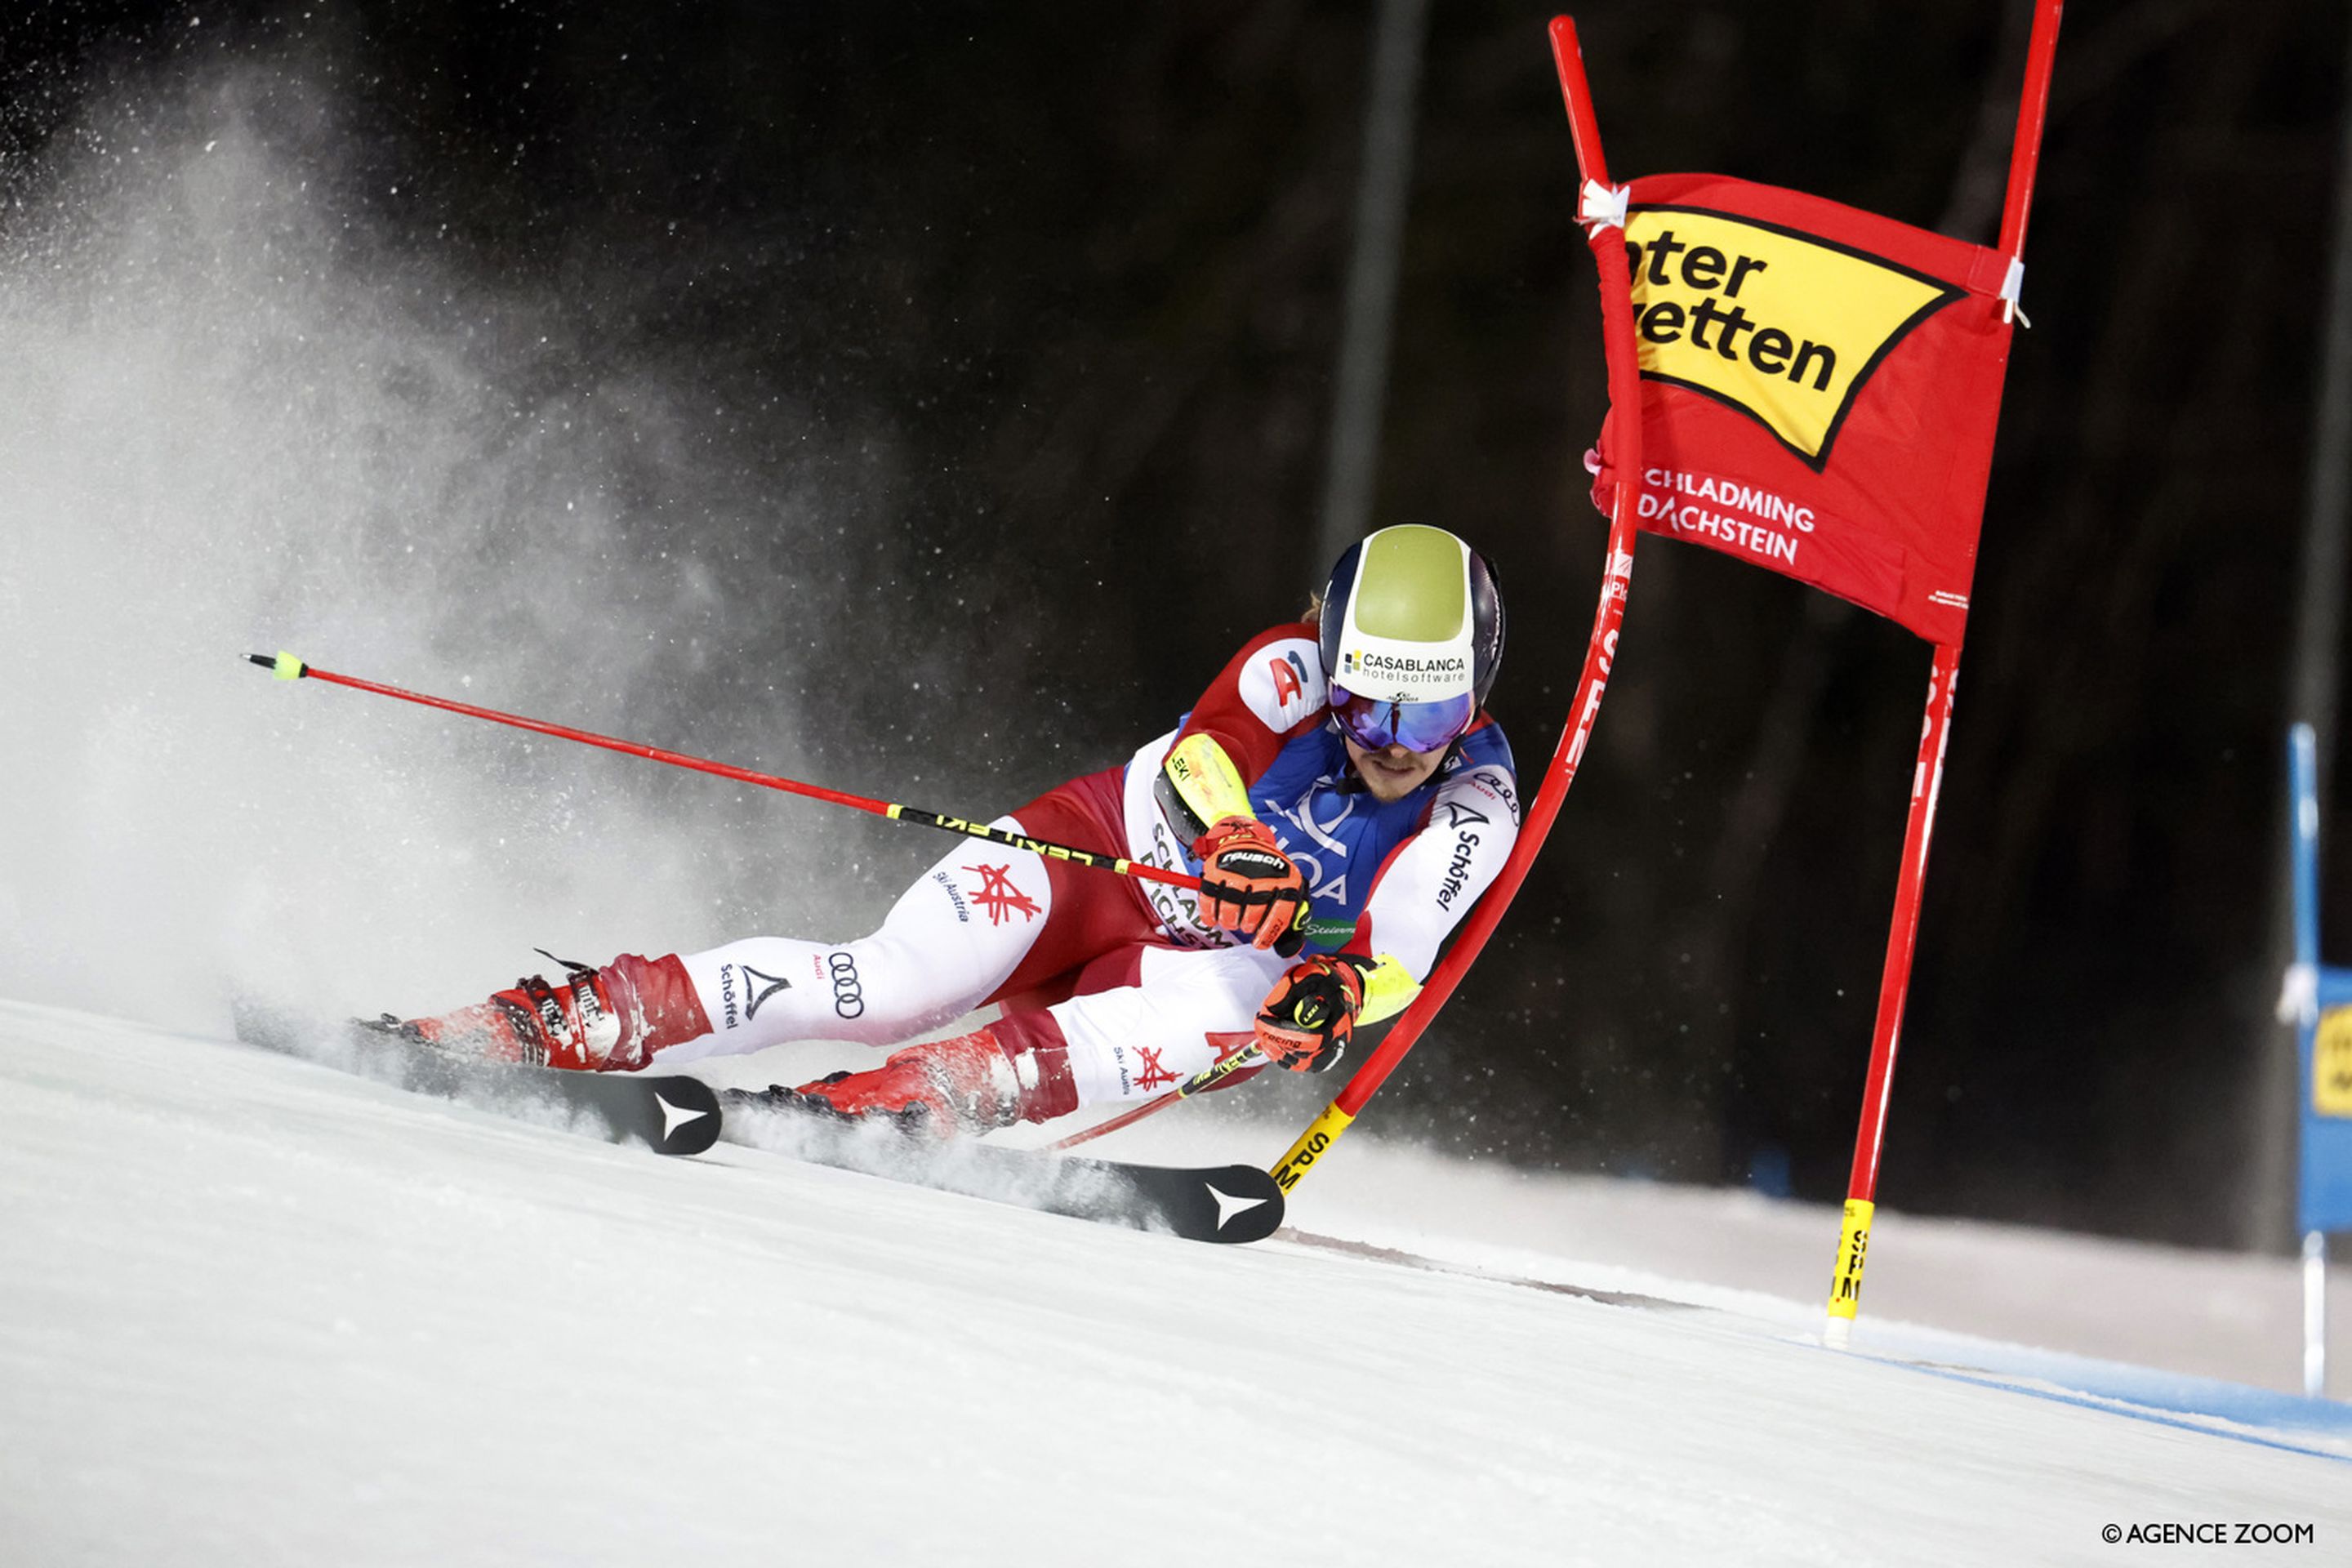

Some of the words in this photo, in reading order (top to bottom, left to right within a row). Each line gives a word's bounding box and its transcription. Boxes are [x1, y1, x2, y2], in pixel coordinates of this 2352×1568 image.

[1633, 296, 1837, 392] etten
[1641, 467, 1815, 532] CHLADMING
[1637, 493, 1798, 566] DACHSTEIN
[1362, 668, 1465, 683] hotelsoftware
[1364, 653, 1465, 672] CASABLANCA
[1471, 782, 1496, 800] Audi
[1016, 838, 1093, 866] LEKI
[1221, 851, 1285, 871] reusch
[1437, 831, 1480, 912] Schöffel
[943, 884, 970, 923] Austria
[720, 963, 738, 1030] Schöffel
[1263, 1031, 1303, 1048] racing
[1273, 1132, 1330, 1190] SPM
